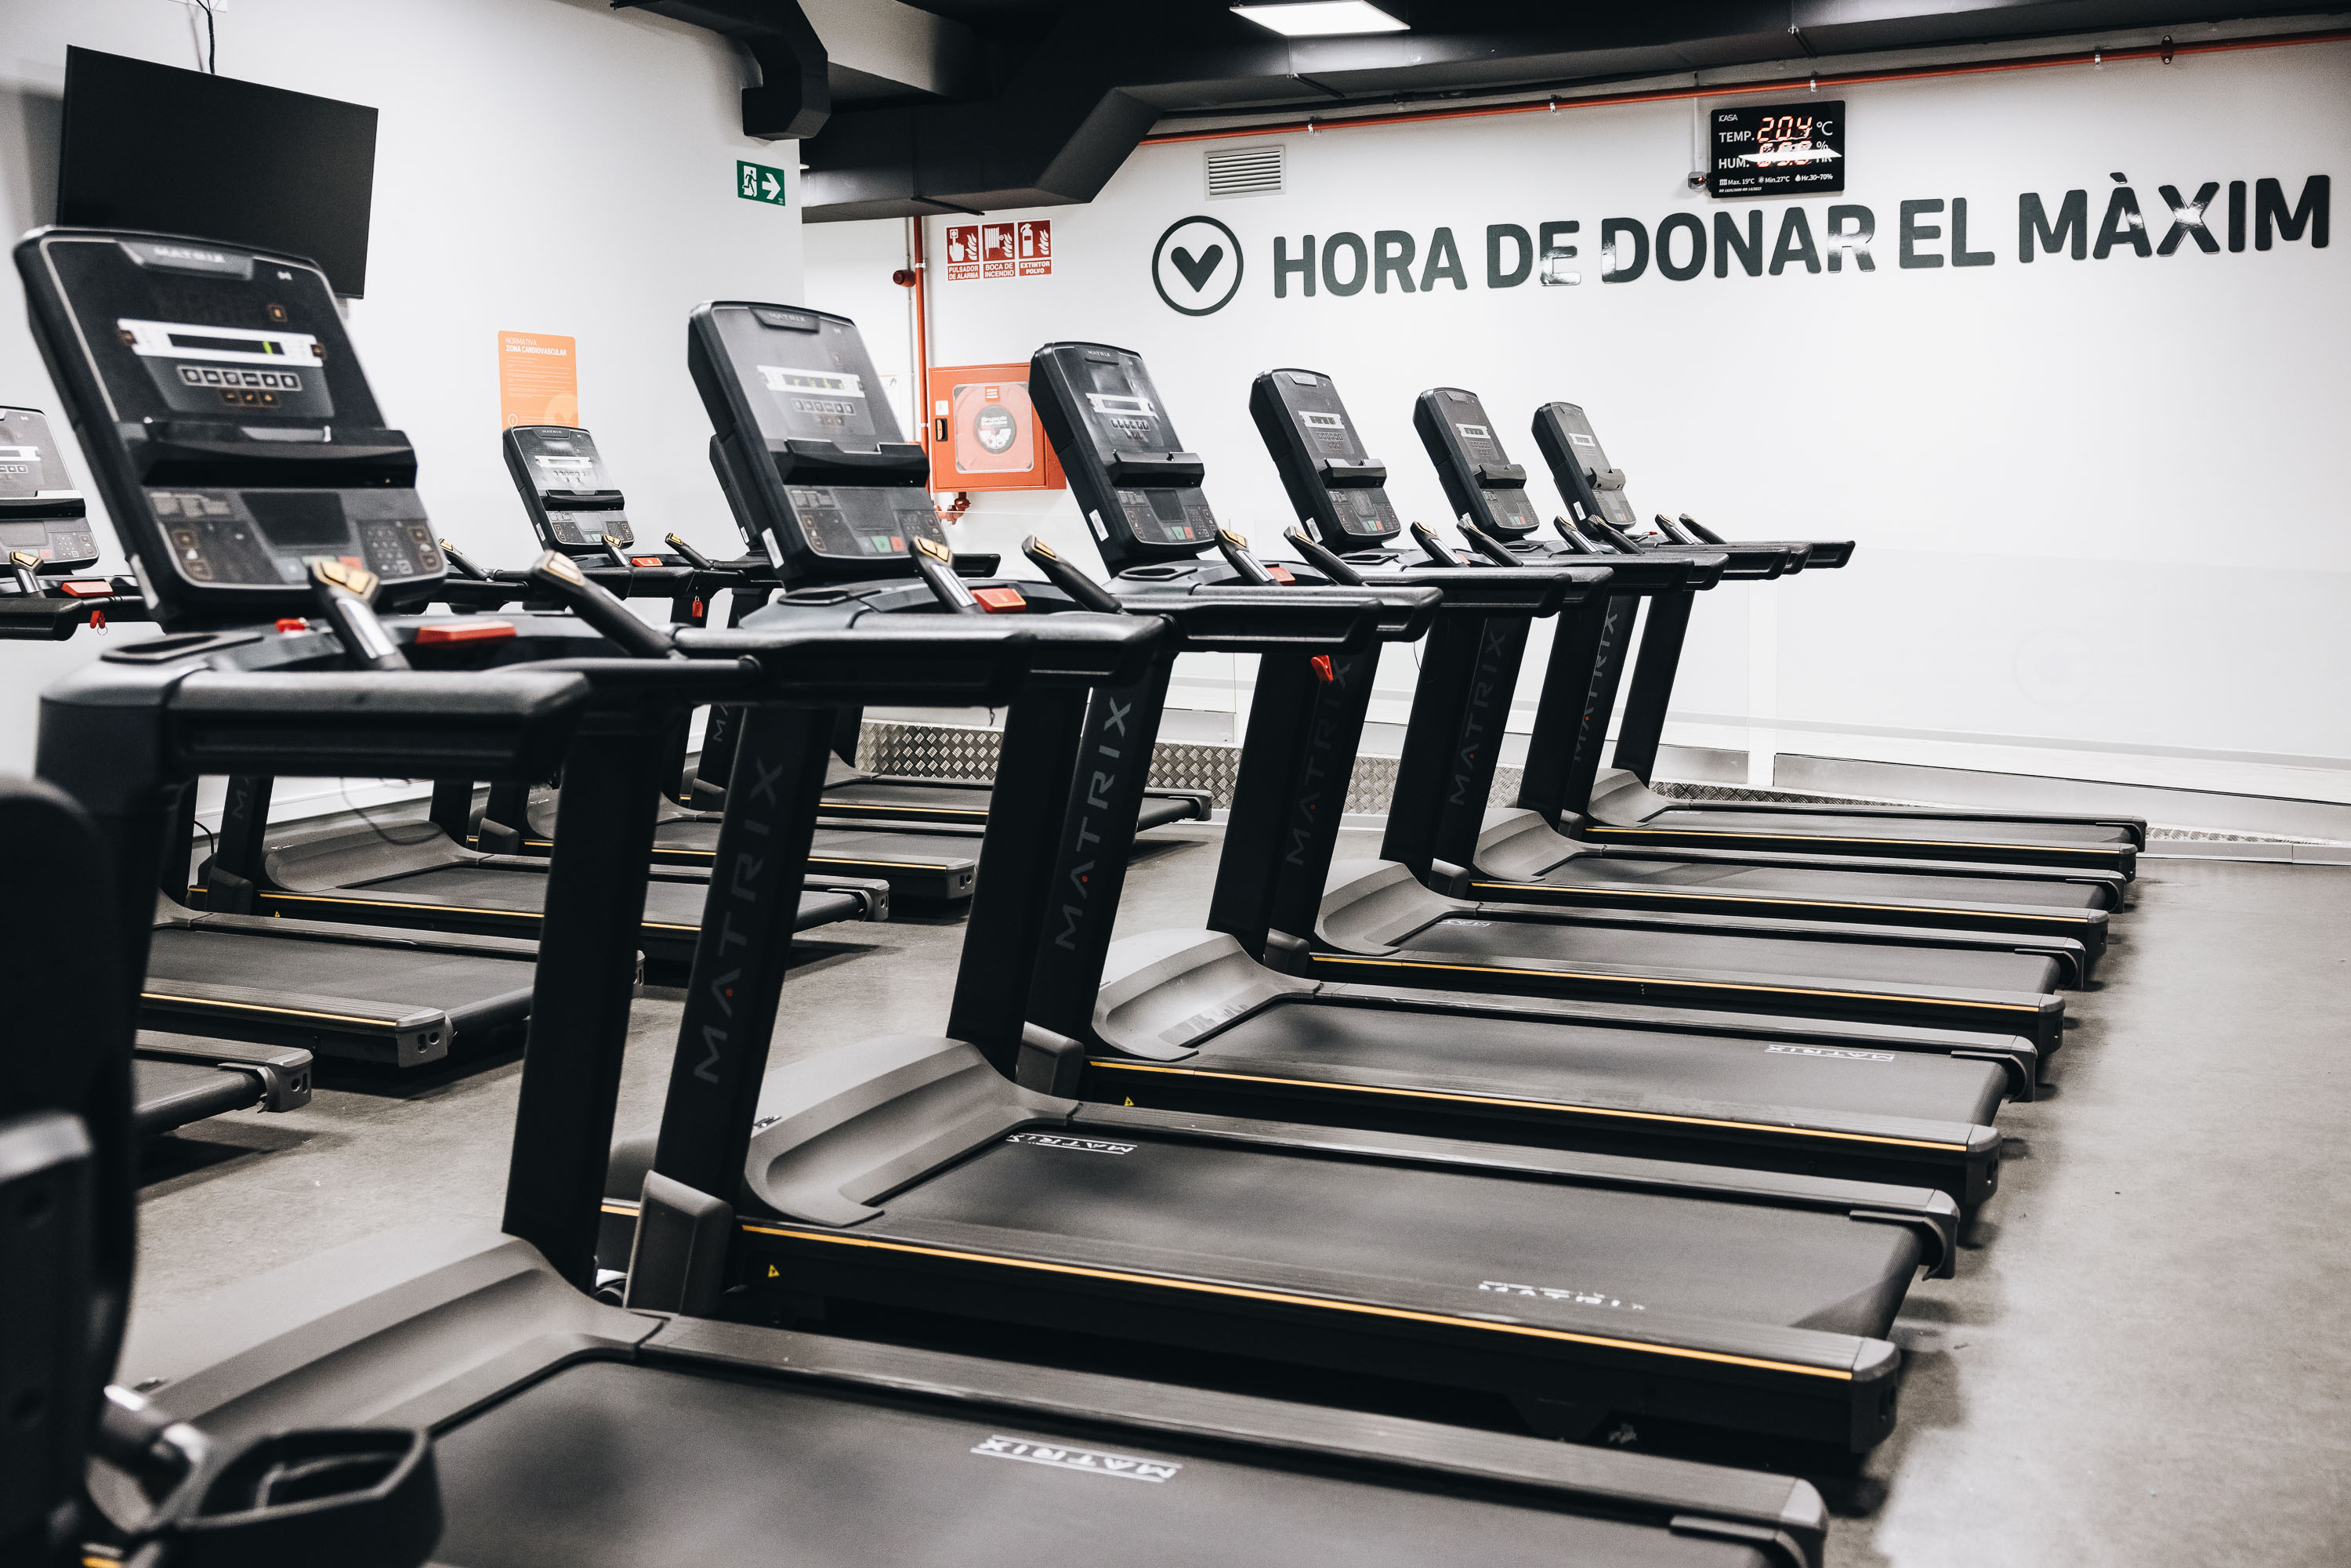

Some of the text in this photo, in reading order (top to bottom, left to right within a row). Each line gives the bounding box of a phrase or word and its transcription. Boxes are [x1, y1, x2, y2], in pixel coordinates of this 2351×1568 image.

[1719, 131, 1755, 143] TEMP.
[1719, 158, 1750, 169] HUM.
[1273, 172, 2331, 299] HORA DE DONAR EL MÀXIM
[1020, 260, 1050, 269] EXTINTOR
[769, 312, 806, 323] MATRIX
[506, 337, 538, 346] NORMATIVA
[522, 346, 567, 357] CARDIOVASCULAR
[1449, 630, 1505, 806] MATRIX
[1286, 658, 1352, 866] MATRIX
[1055, 697, 1132, 951] MATRIX
[693, 757, 783, 1085] MATRIX
[1766, 1045, 1895, 1061] MATRIX
[976, 1438, 1178, 1479] MATRIX
